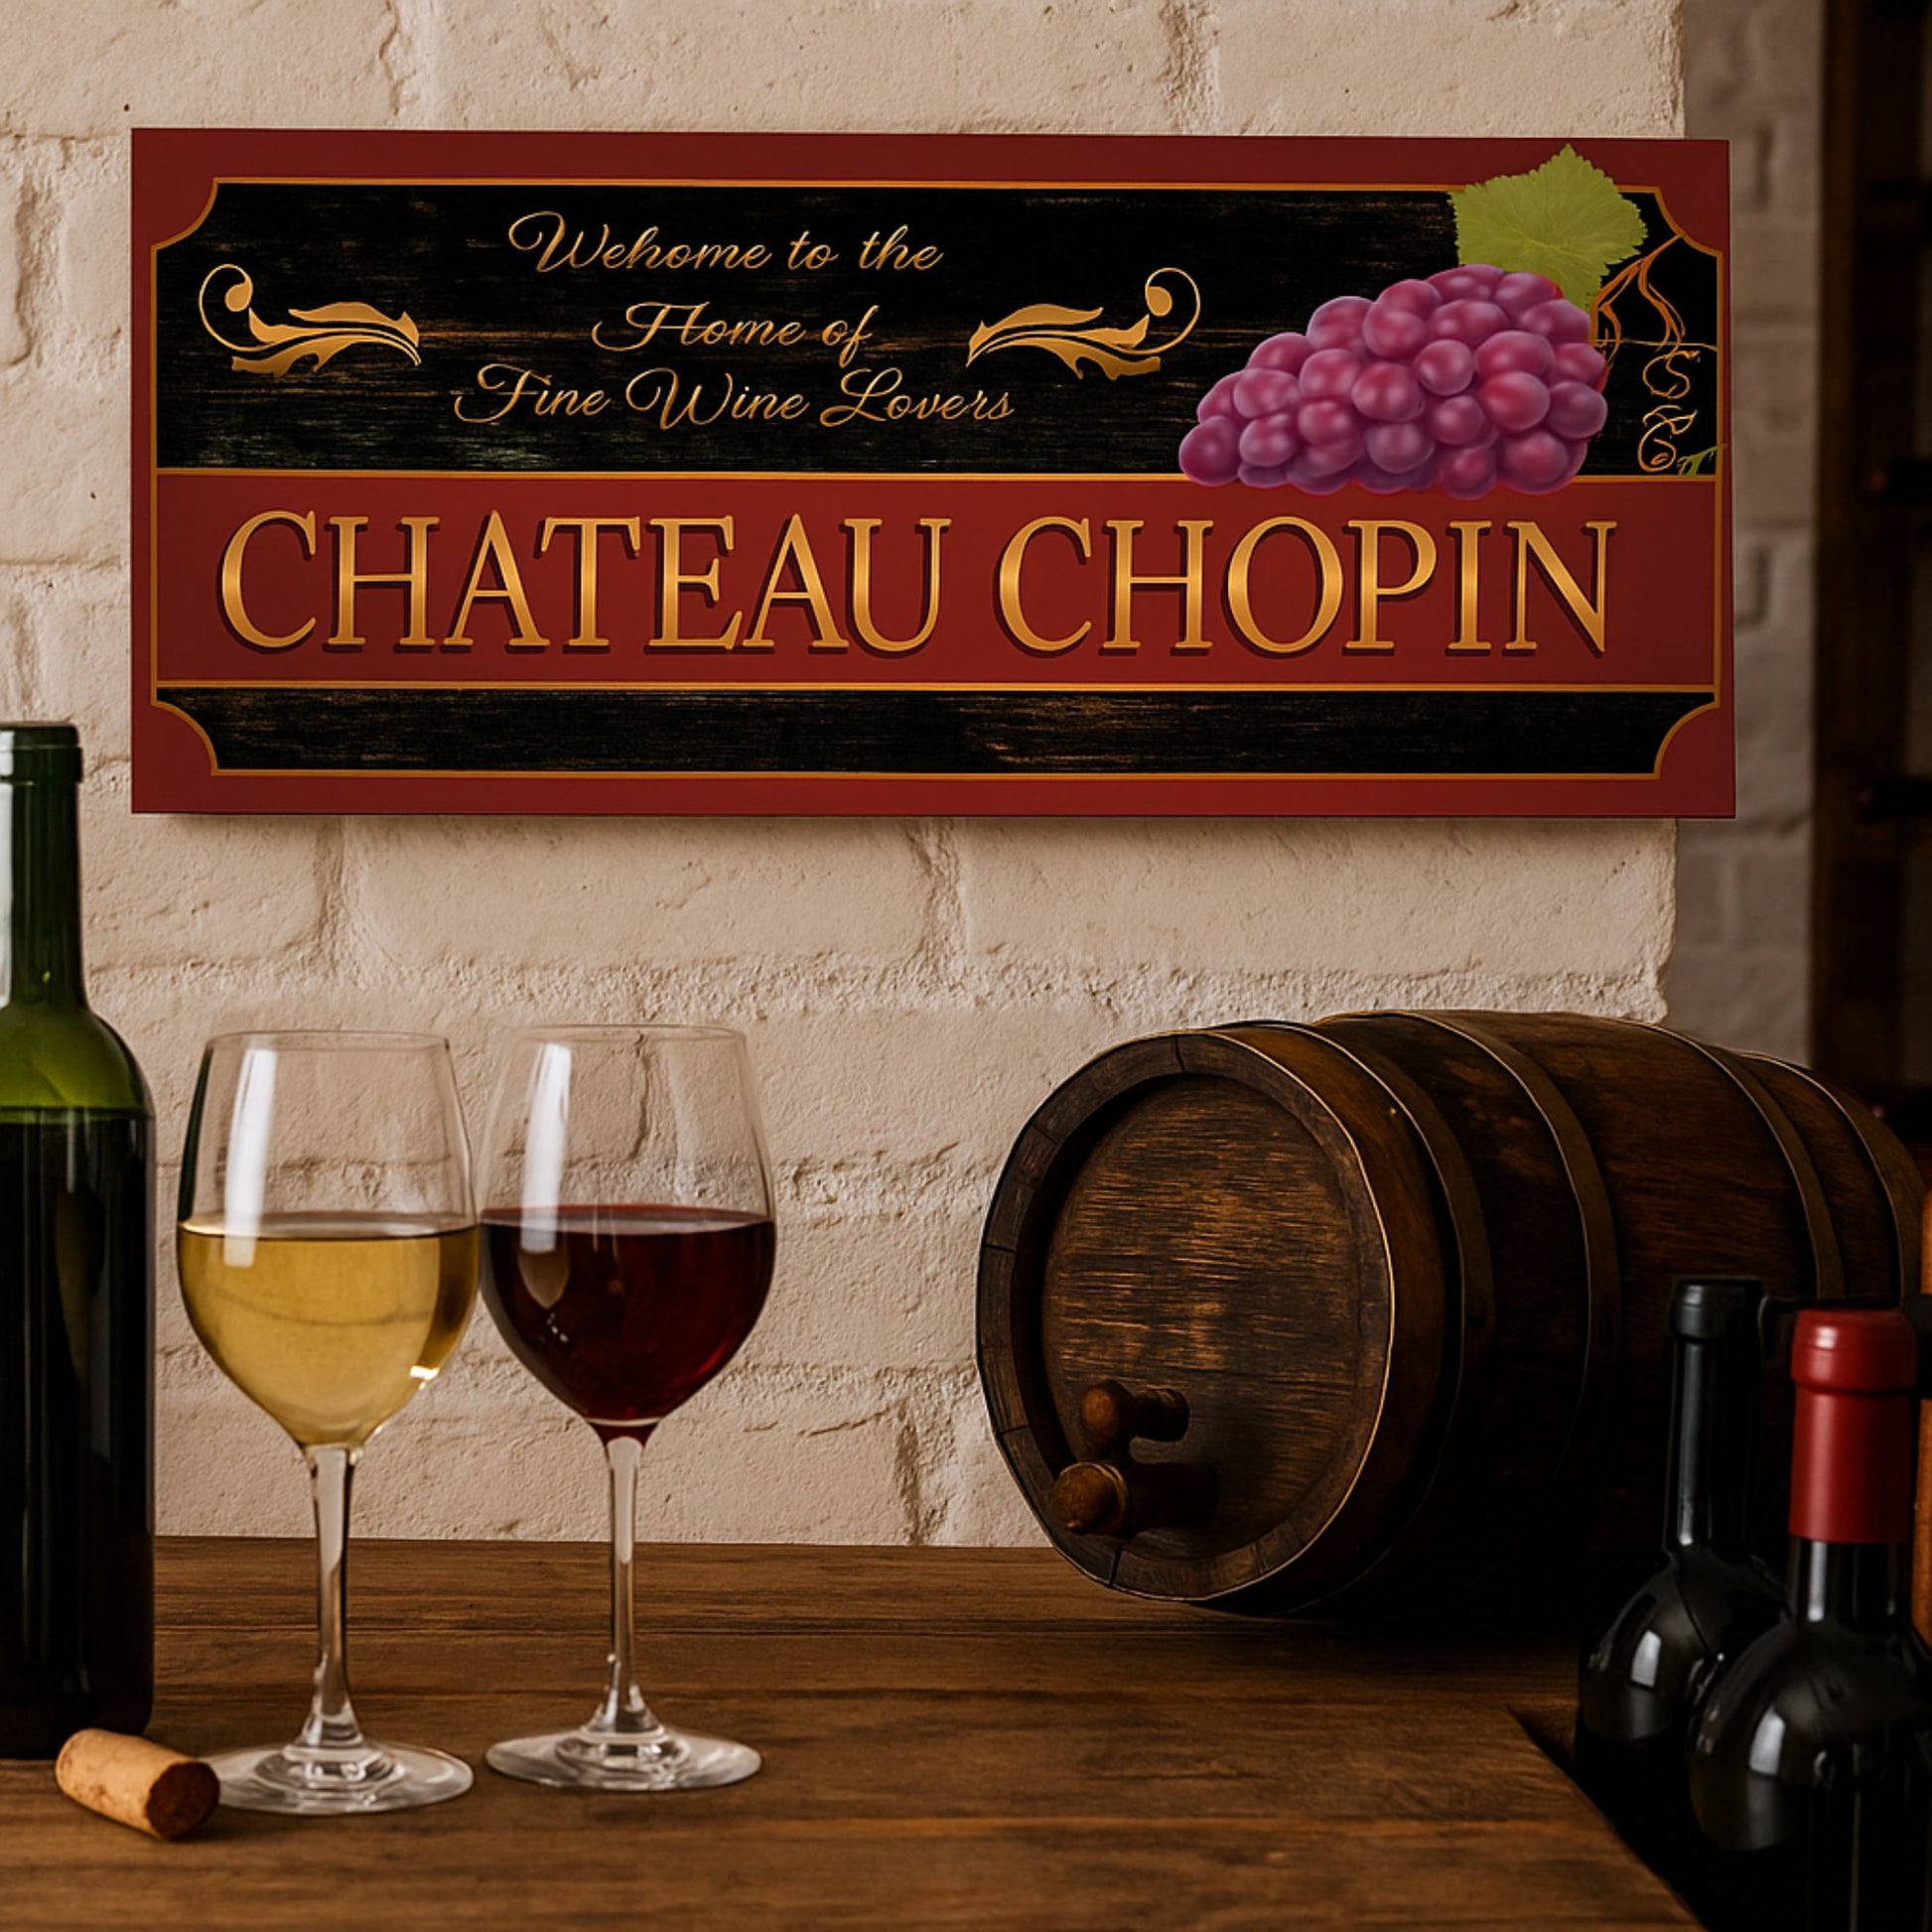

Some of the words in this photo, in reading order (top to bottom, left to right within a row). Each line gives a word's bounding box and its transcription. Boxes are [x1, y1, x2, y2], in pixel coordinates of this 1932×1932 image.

[786, 229, 839, 271] to
[859, 224, 944, 271] the
[591, 301, 807, 352] Home
[820, 304, 880, 368] of
[453, 363, 612, 425] Fine
[624, 366, 810, 431] Wine
[819, 366, 1015, 429] Lovers
[219, 509, 953, 653] CHATEAU
[997, 514, 1618, 654] CHOPIN
